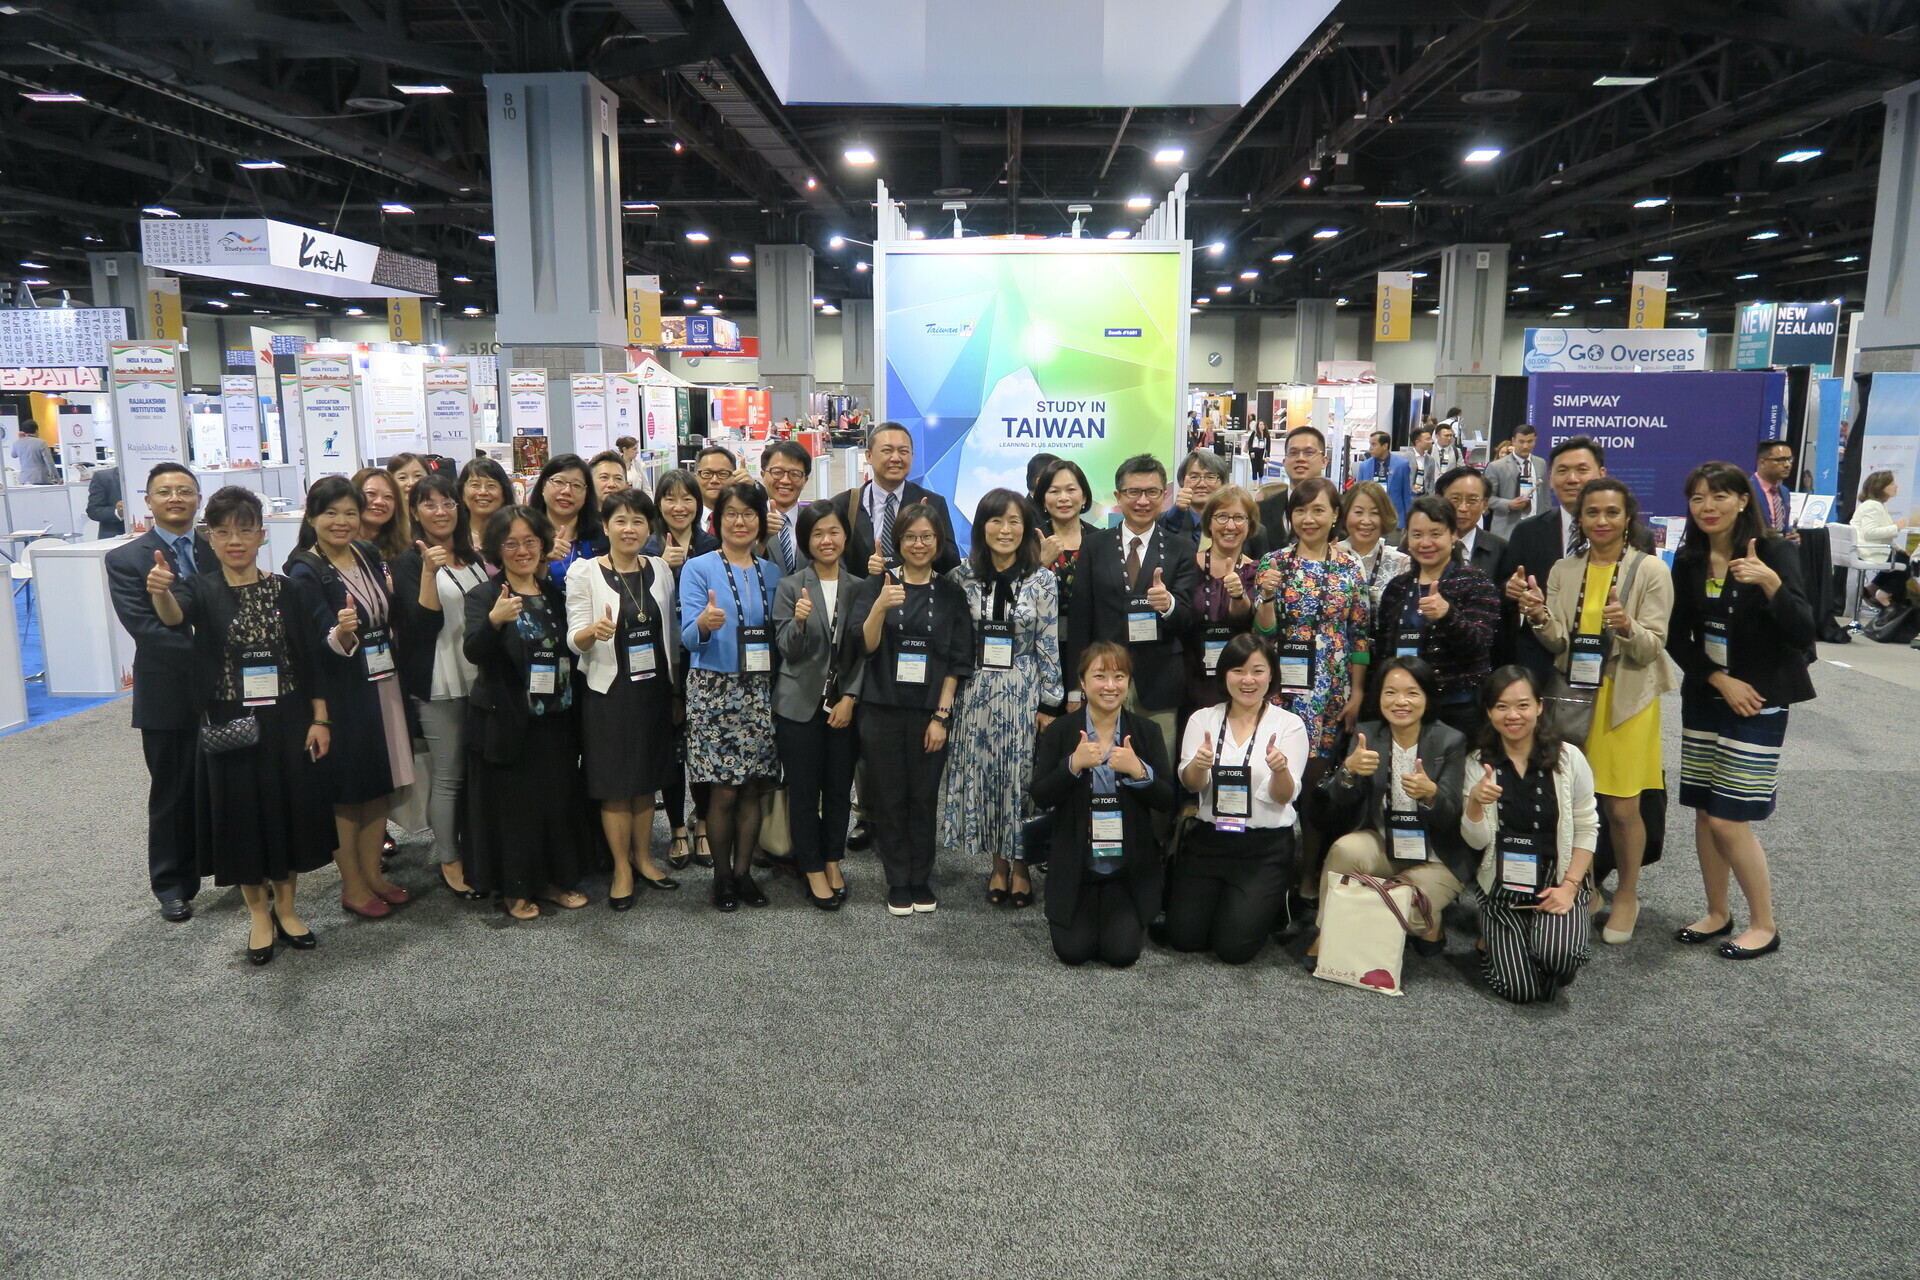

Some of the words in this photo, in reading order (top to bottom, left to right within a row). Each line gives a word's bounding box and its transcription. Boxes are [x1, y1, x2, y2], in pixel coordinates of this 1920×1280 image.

[504, 92, 513, 106] B
[503, 107, 517, 120] 10
[154, 290, 165, 340] 1300
[633, 289, 642, 338] 1500
[1382, 285, 1391, 336] 1800
[1778, 307, 1808, 320] NEW
[393, 297, 403, 338] 400
[1740, 308, 1773, 334] NEW
[925, 323, 959, 334] Taiwan
[1776, 322, 1834, 335] ZEALAND
[1610, 344, 1695, 362] Overseas
[1036, 400, 1087, 413] STUDY
[1091, 401, 1106, 413] IN
[1553, 394, 1621, 407] SIMPWAY
[1001, 417, 1105, 439] TAIWAN
[1551, 416, 1668, 428] INTERNATIONAL
[1769, 404, 1778, 440] SIMPWAY
[448, 430, 464, 438] VIT
[127, 443, 169, 454] Rajalakshmi
[1550, 436, 1636, 449] EDATION
[992, 624, 1008, 632] TOEFL
[1710, 621, 1726, 630] TOEFL
[1291, 643, 1309, 651] TOEFL
[1583, 637, 1600, 645] TOEFL
[252, 650, 273, 659] TOEFL
[541, 651, 555, 659] TOEFL
[1513, 837, 1534, 846] TOEFL
